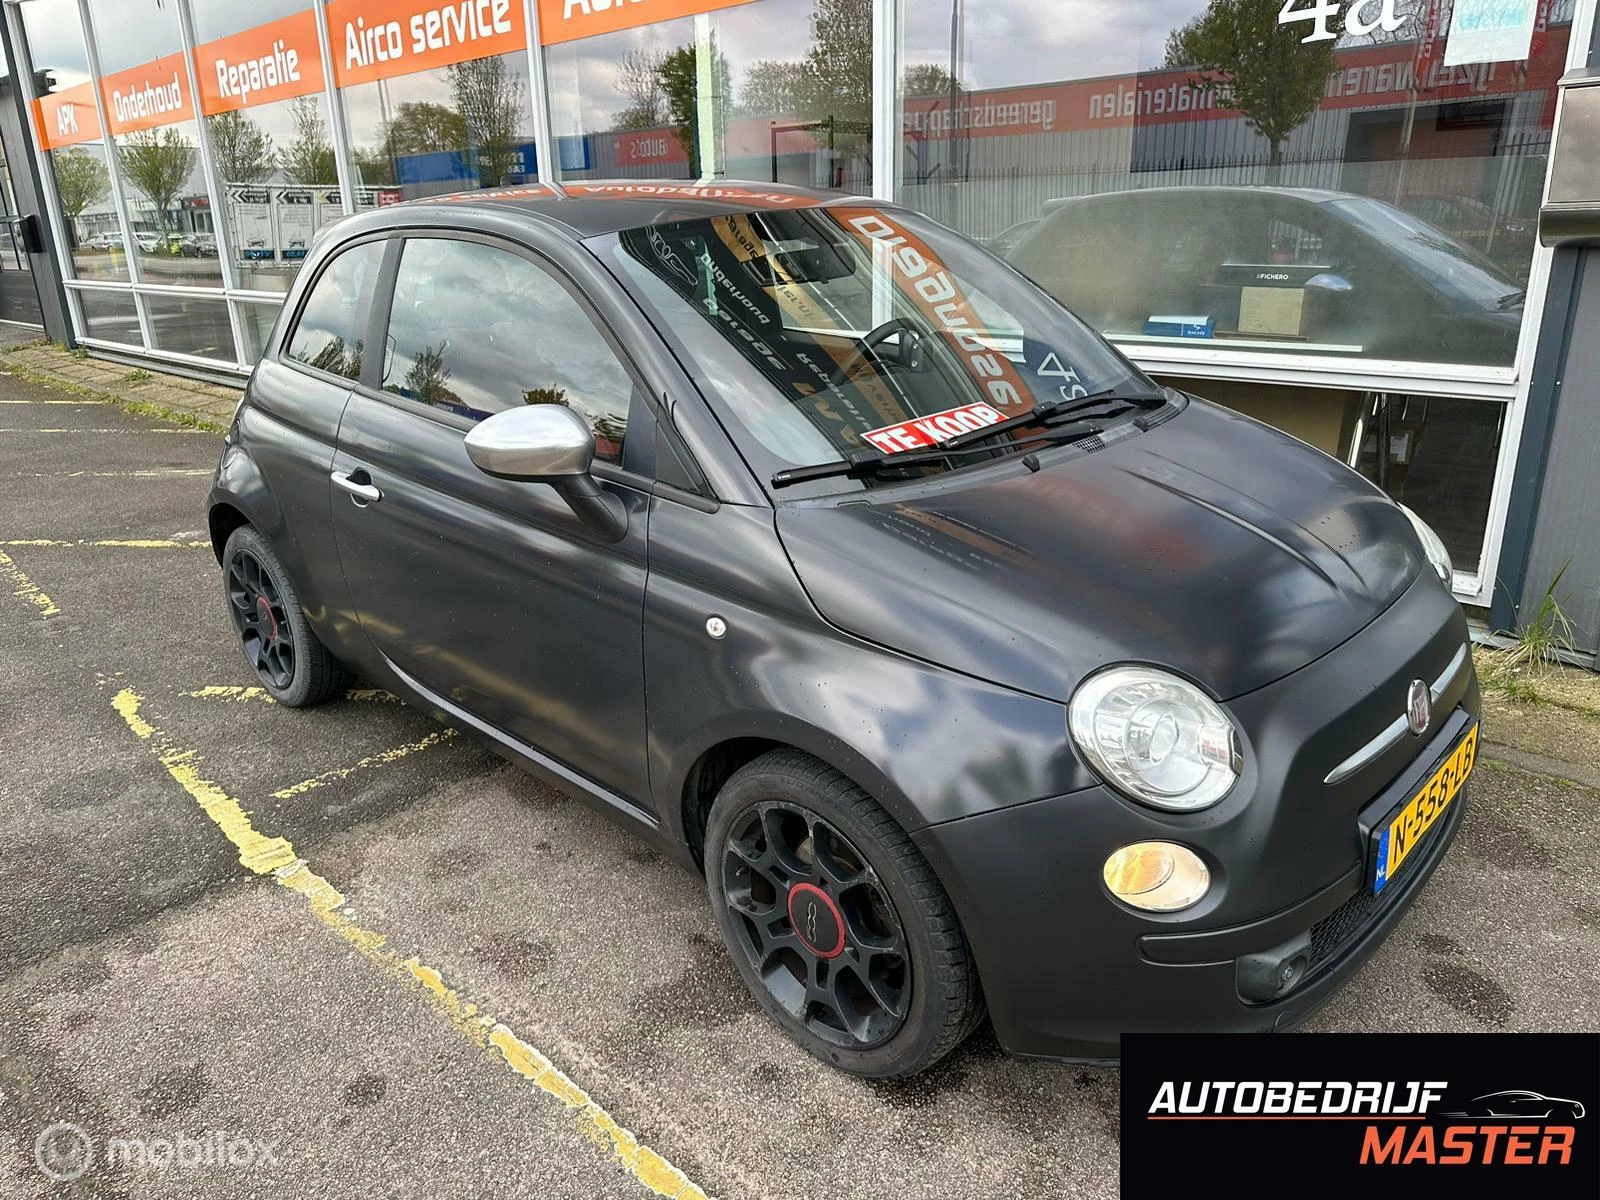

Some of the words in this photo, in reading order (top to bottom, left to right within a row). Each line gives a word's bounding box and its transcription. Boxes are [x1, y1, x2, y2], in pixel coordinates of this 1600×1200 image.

[345, 15, 403, 70] Airco
[409, 0, 512, 54] service
[215, 38, 301, 104] Reparatie
[56, 103, 79, 136] APK
[112, 72, 183, 123] Onderhoud
[869, 427, 928, 453] TE
[913, 406, 1000, 443] KOOP
[1392, 736, 1474, 865] N-558-LB
[1376, 864, 1386, 881] NL
